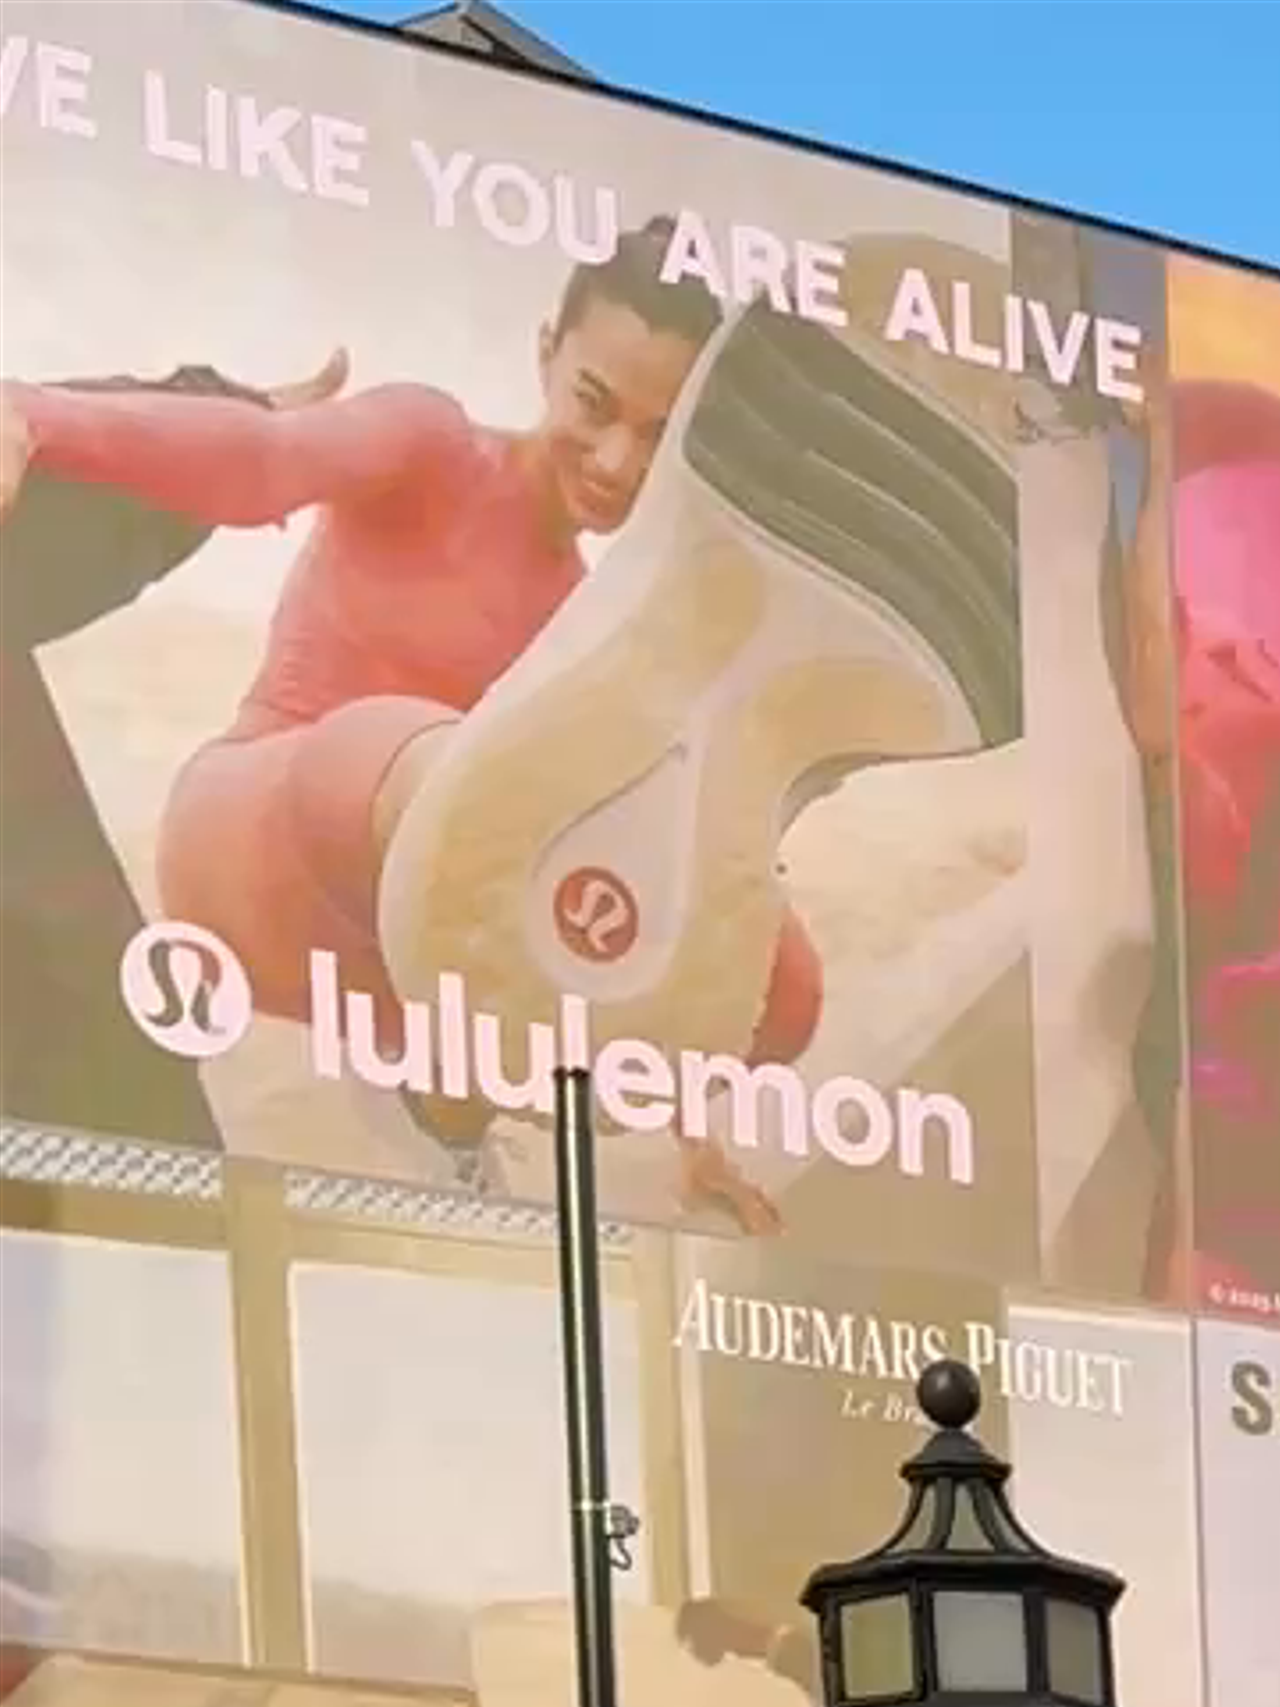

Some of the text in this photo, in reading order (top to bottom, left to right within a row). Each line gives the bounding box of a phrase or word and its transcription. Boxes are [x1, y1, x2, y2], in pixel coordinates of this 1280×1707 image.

[144, 70, 370, 206] LIKE
[410, 140, 621, 264] YOU
[660, 212, 848, 327] ARE
[885, 267, 1146, 401] ALIVE
[309, 949, 975, 1185] lululemon
[673, 1277, 1134, 1416] AUDEMARS PIGUET
